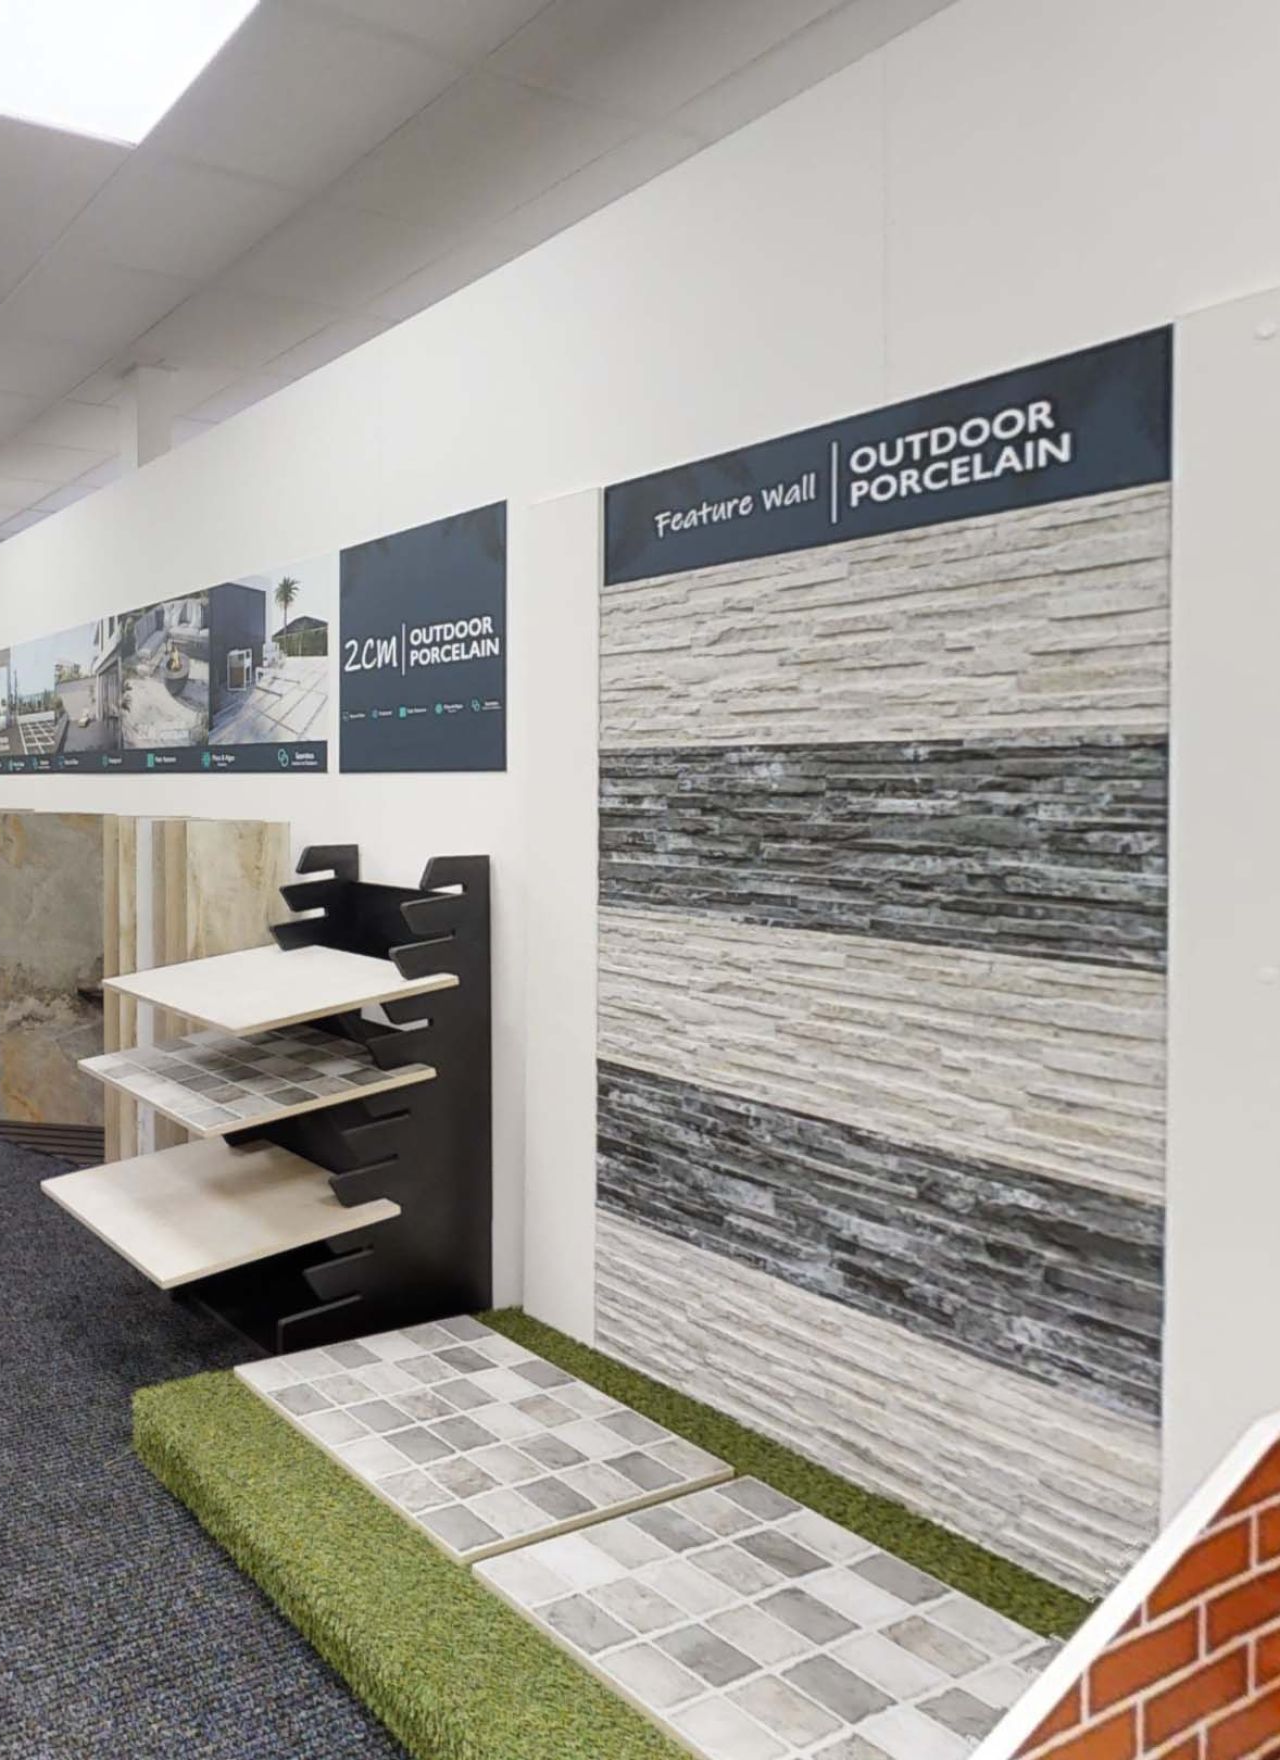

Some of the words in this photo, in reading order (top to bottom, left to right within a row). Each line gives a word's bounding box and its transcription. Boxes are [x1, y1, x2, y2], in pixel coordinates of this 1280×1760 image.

[849, 401, 1055, 474] OUTDOOR
[849, 432, 1072, 508] PORCELAIN
[654, 495, 754, 538] Feature
[761, 472, 816, 511] Wall
[344, 635, 398, 672] 2CM
[409, 616, 494, 646] OUTDOOR
[409, 637, 500, 667] PORCELAIN
